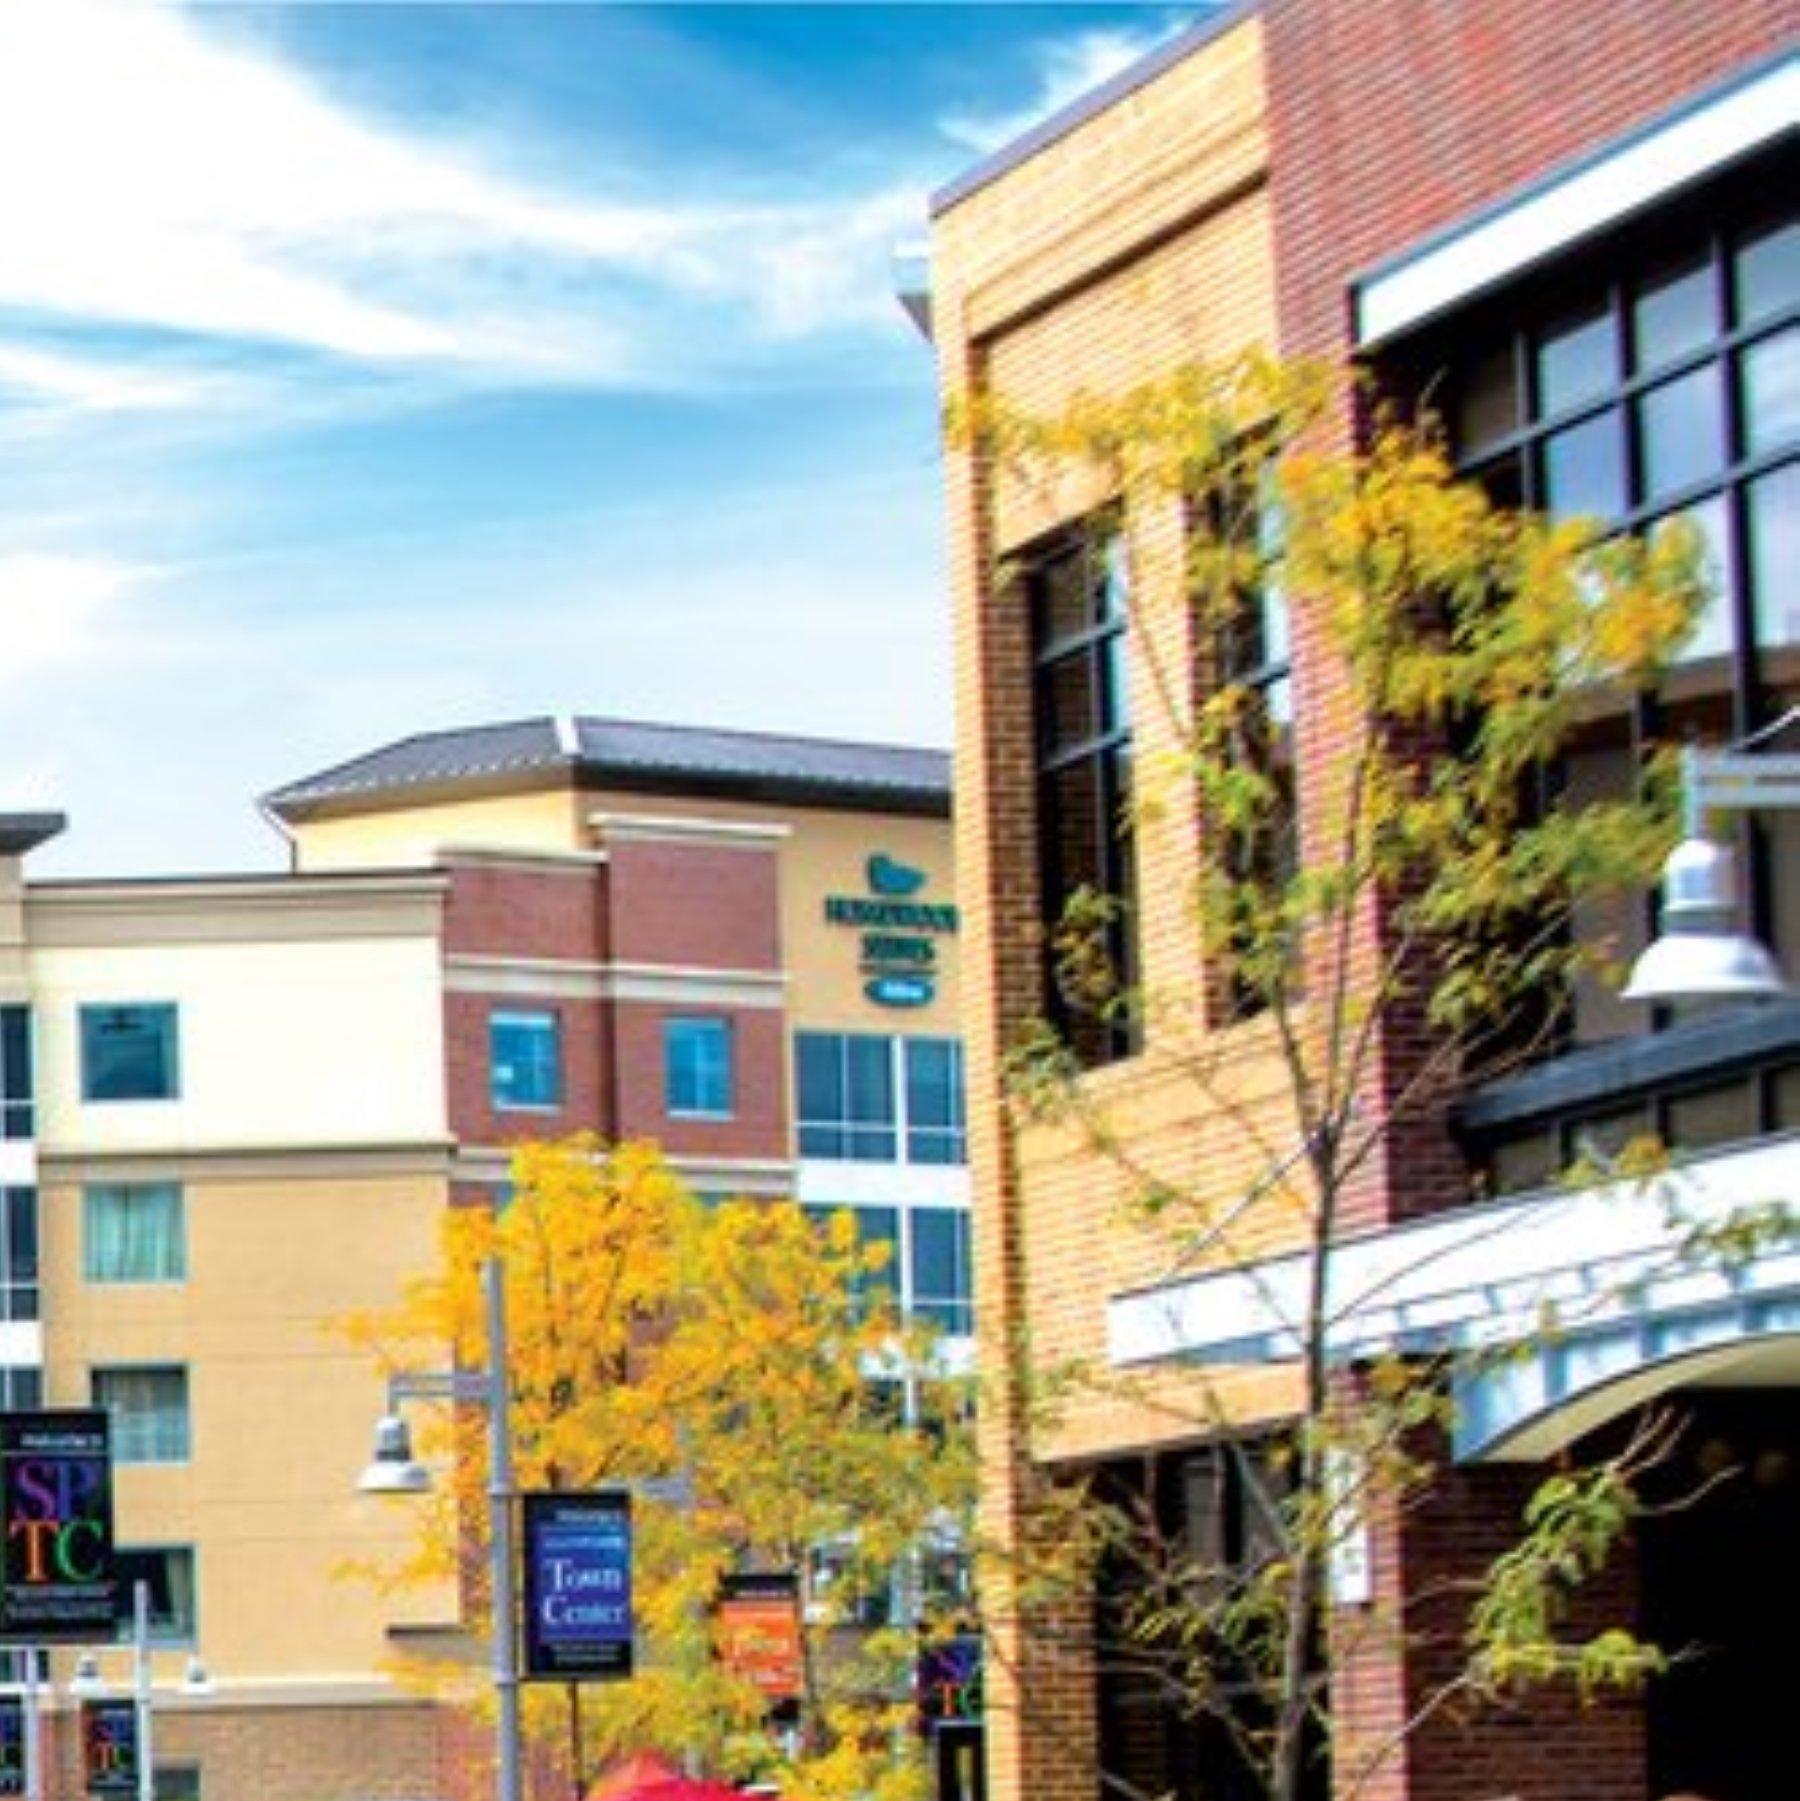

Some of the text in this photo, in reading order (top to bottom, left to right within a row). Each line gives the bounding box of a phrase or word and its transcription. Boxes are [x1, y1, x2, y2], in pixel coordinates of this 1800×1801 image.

[13, 1459, 99, 1520] SP
[8, 1519, 103, 1582] TC
[543, 1558, 622, 1592] Town
[543, 1596, 623, 1626] Center
